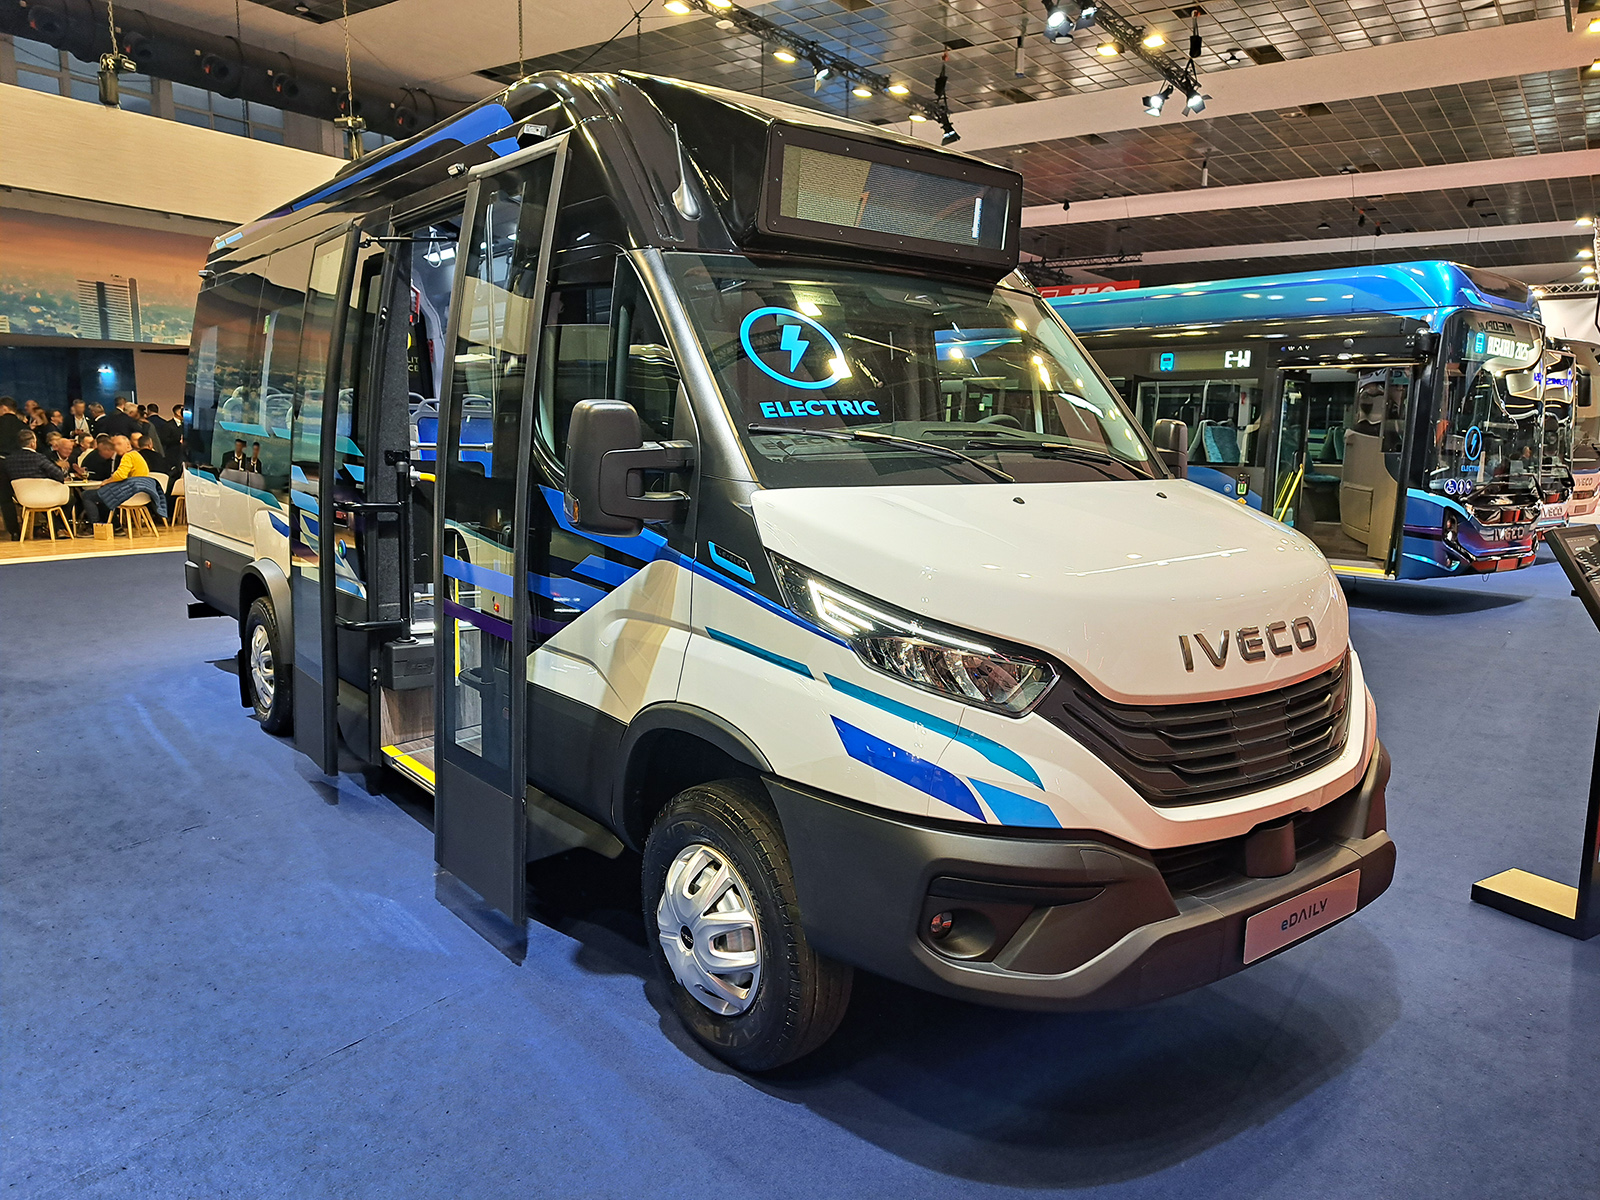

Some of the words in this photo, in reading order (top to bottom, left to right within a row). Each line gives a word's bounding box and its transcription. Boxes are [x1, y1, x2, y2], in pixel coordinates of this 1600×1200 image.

[1224, 350, 1251, 369] E-W
[759, 399, 880, 419] ELECTRIC
[1178, 615, 1318, 673] IVECO
[1280, 897, 1328, 932] eDAILY
